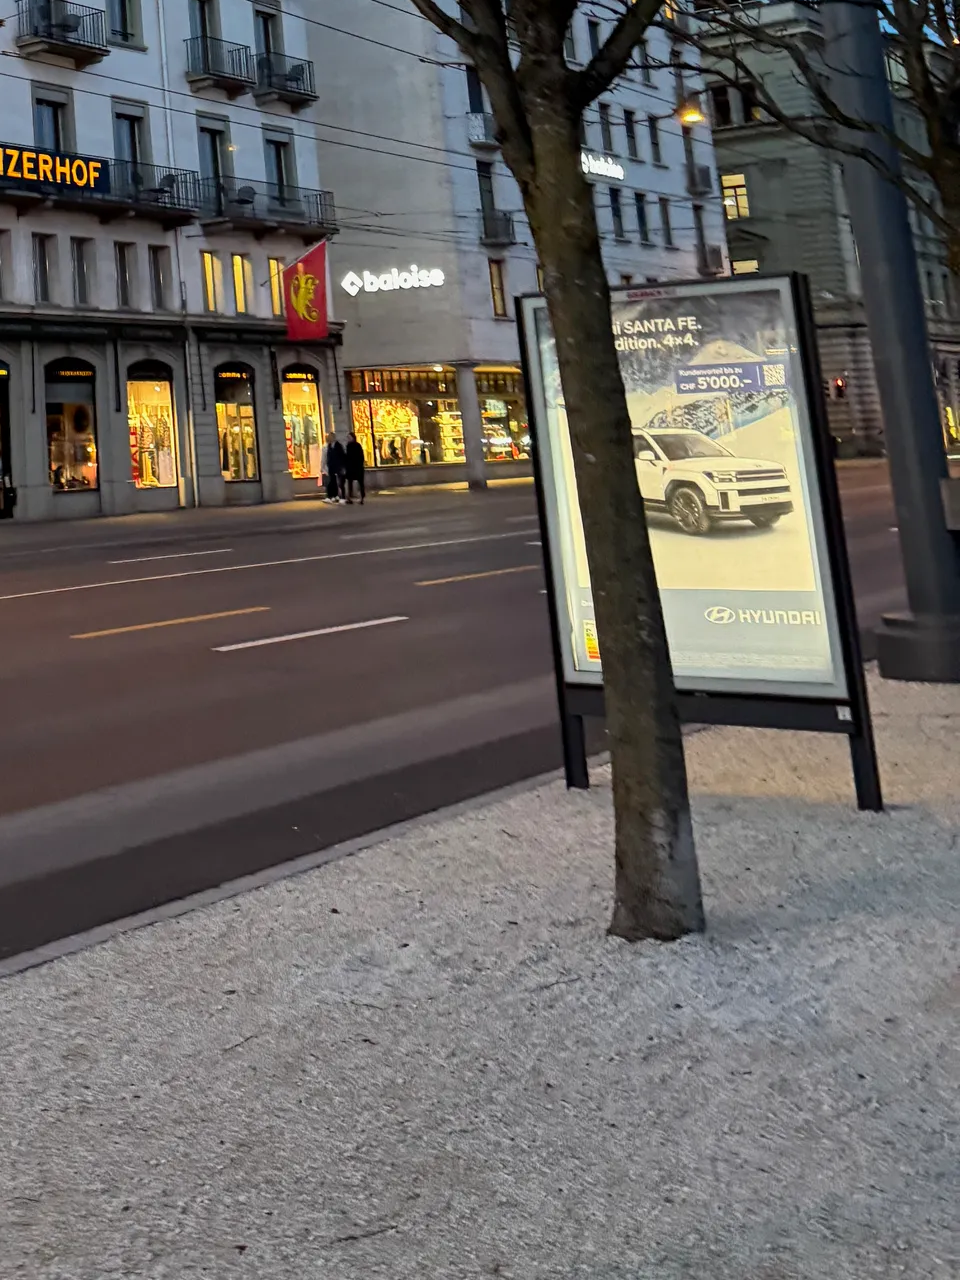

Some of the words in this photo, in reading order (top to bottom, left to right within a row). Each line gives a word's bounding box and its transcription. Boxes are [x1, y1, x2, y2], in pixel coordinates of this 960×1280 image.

[363, 264, 445, 292] baloise
[624, 318, 675, 335] SANTA
[677, 316, 702, 331] FE.
[614, 336, 661, 351] dition.
[737, 609, 822, 625] HYUNDAI
